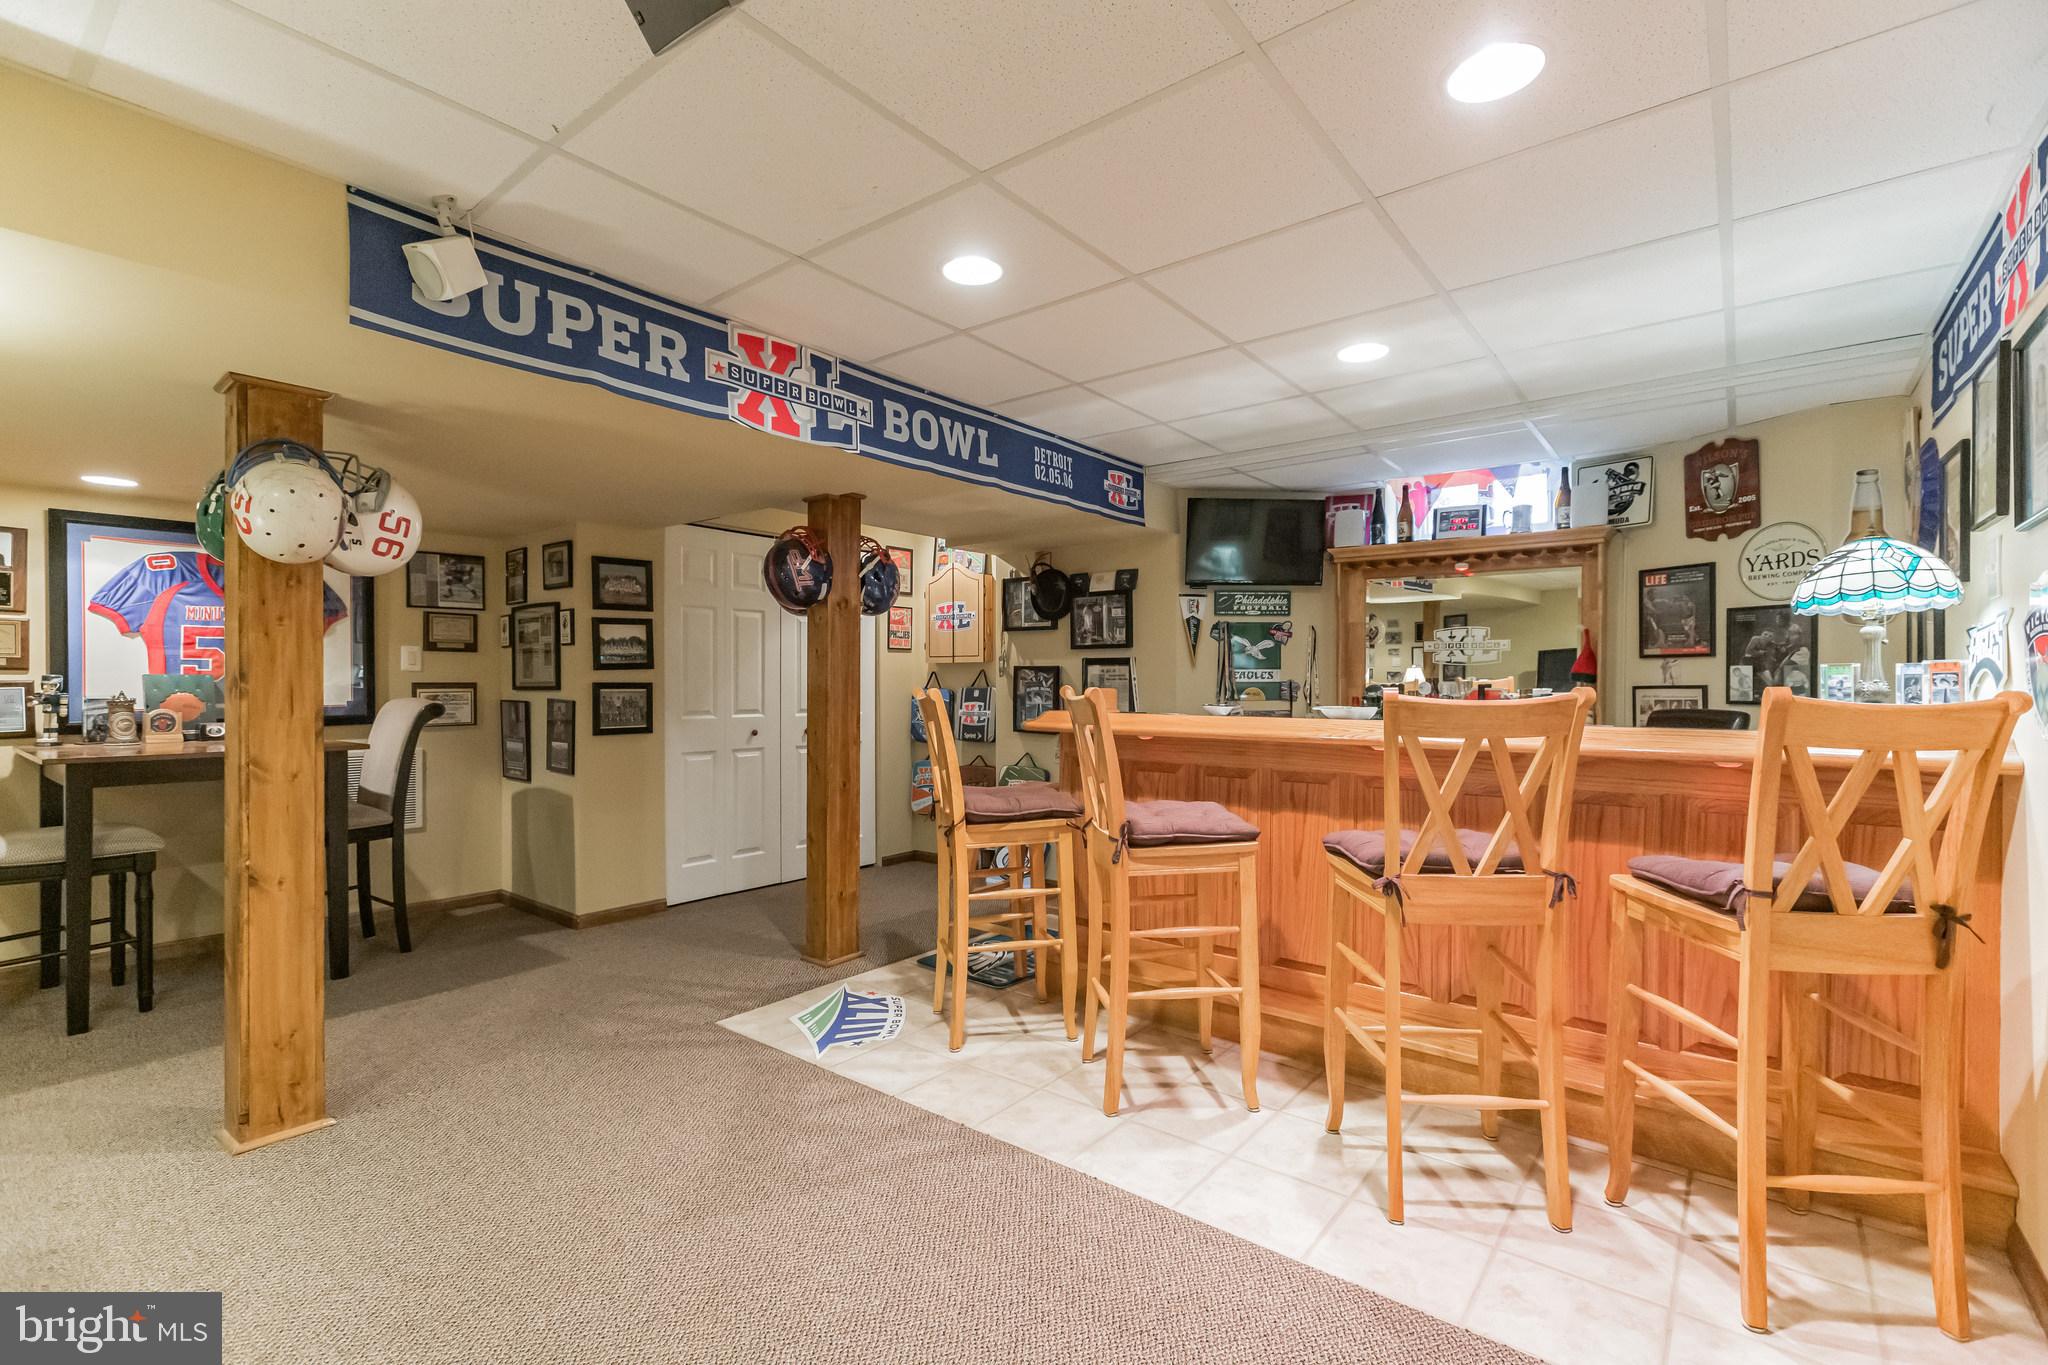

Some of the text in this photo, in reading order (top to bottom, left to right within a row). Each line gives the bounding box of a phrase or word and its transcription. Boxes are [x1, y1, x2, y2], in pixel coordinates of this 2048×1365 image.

[1938, 271, 1992, 392] SUPER
[730, 365, 856, 414] SUPER BOWL
[883, 398, 999, 467] BOWL
[1034, 446, 1073, 472] DETROIT
[1034, 464, 1073, 489] 02.05.06
[1738, 494, 1756, 503] 2005
[371, 511, 411, 560] 56
[1746, 549, 1820, 572] YARDS
[1645, 574, 1667, 586] LIFE
[1748, 573, 1780, 581] BREWING
[1235, 595, 1288, 606] Philadelphia
[185, 605, 225, 621] MINU
[1233, 671, 1274, 680] EAGLES
